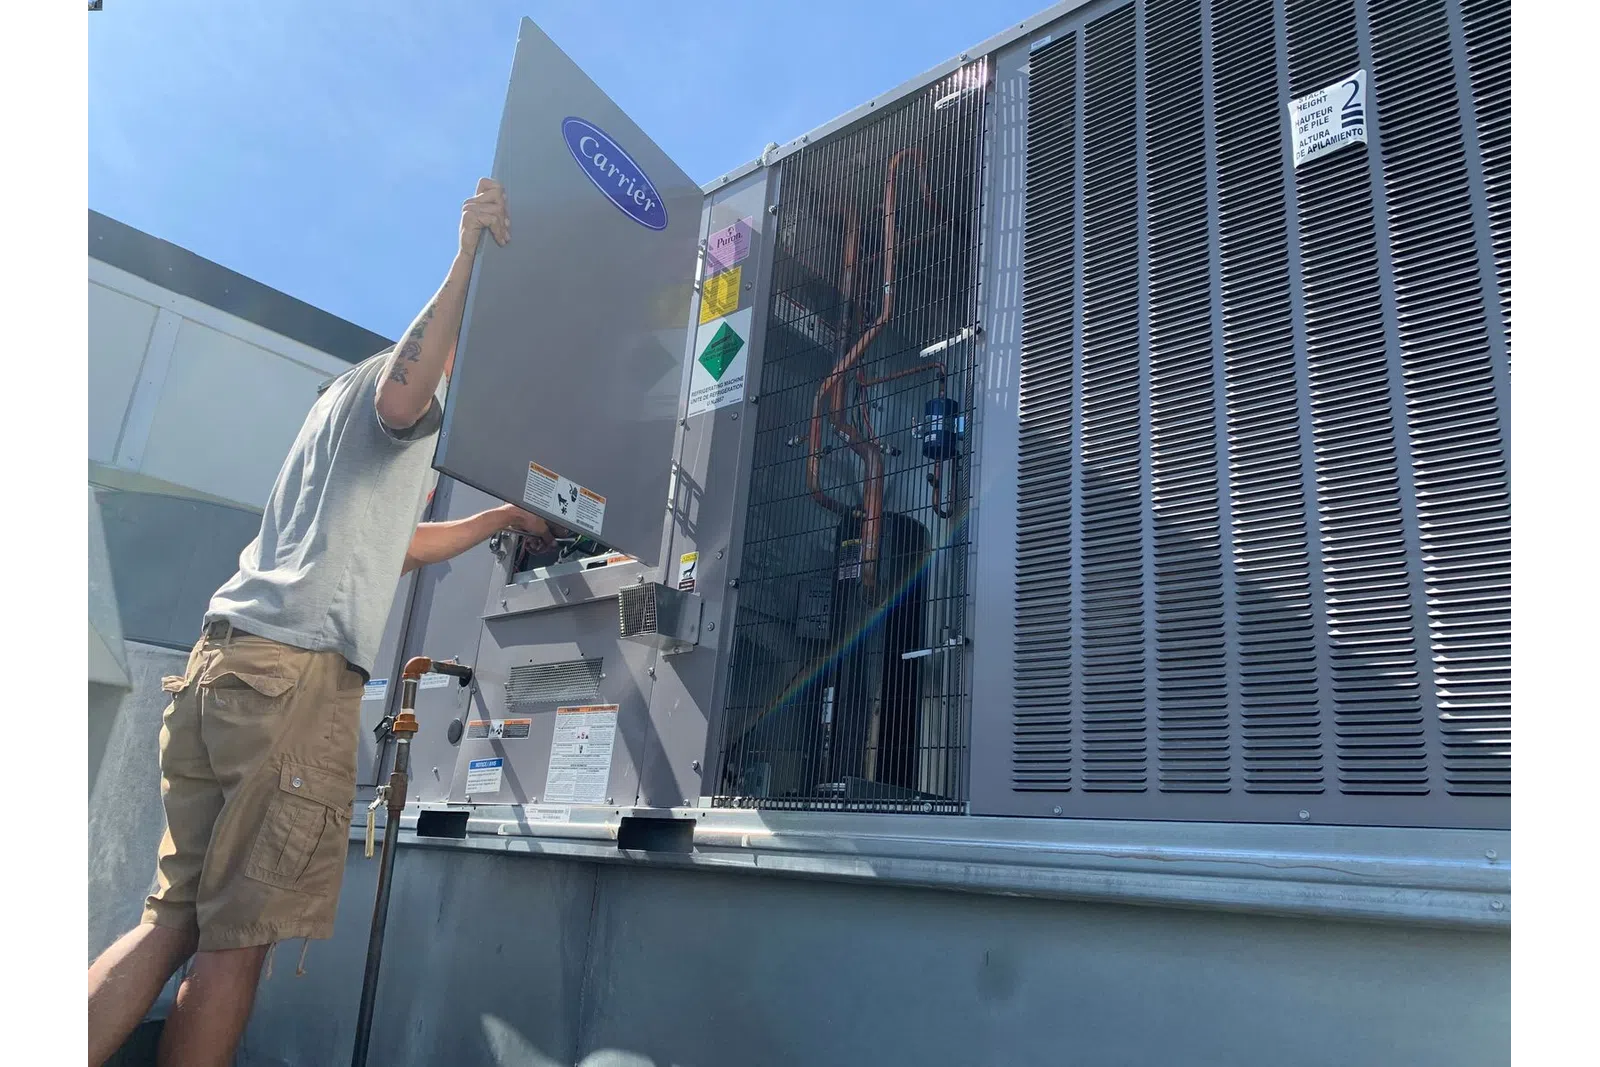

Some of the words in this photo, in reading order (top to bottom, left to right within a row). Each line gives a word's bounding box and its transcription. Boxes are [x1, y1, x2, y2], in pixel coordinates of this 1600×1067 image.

[1296, 94, 1328, 111] HEIGHT
[1341, 79, 1362, 111] 2
[1295, 106, 1333, 126] HAUTEUR
[1299, 123, 1309, 134] DE
[1311, 116, 1330, 129] PILE
[1299, 129, 1330, 148] ALTURA
[1307, 128, 1364, 155] APILAMIENTO
[579, 136, 655, 212] Carrier
